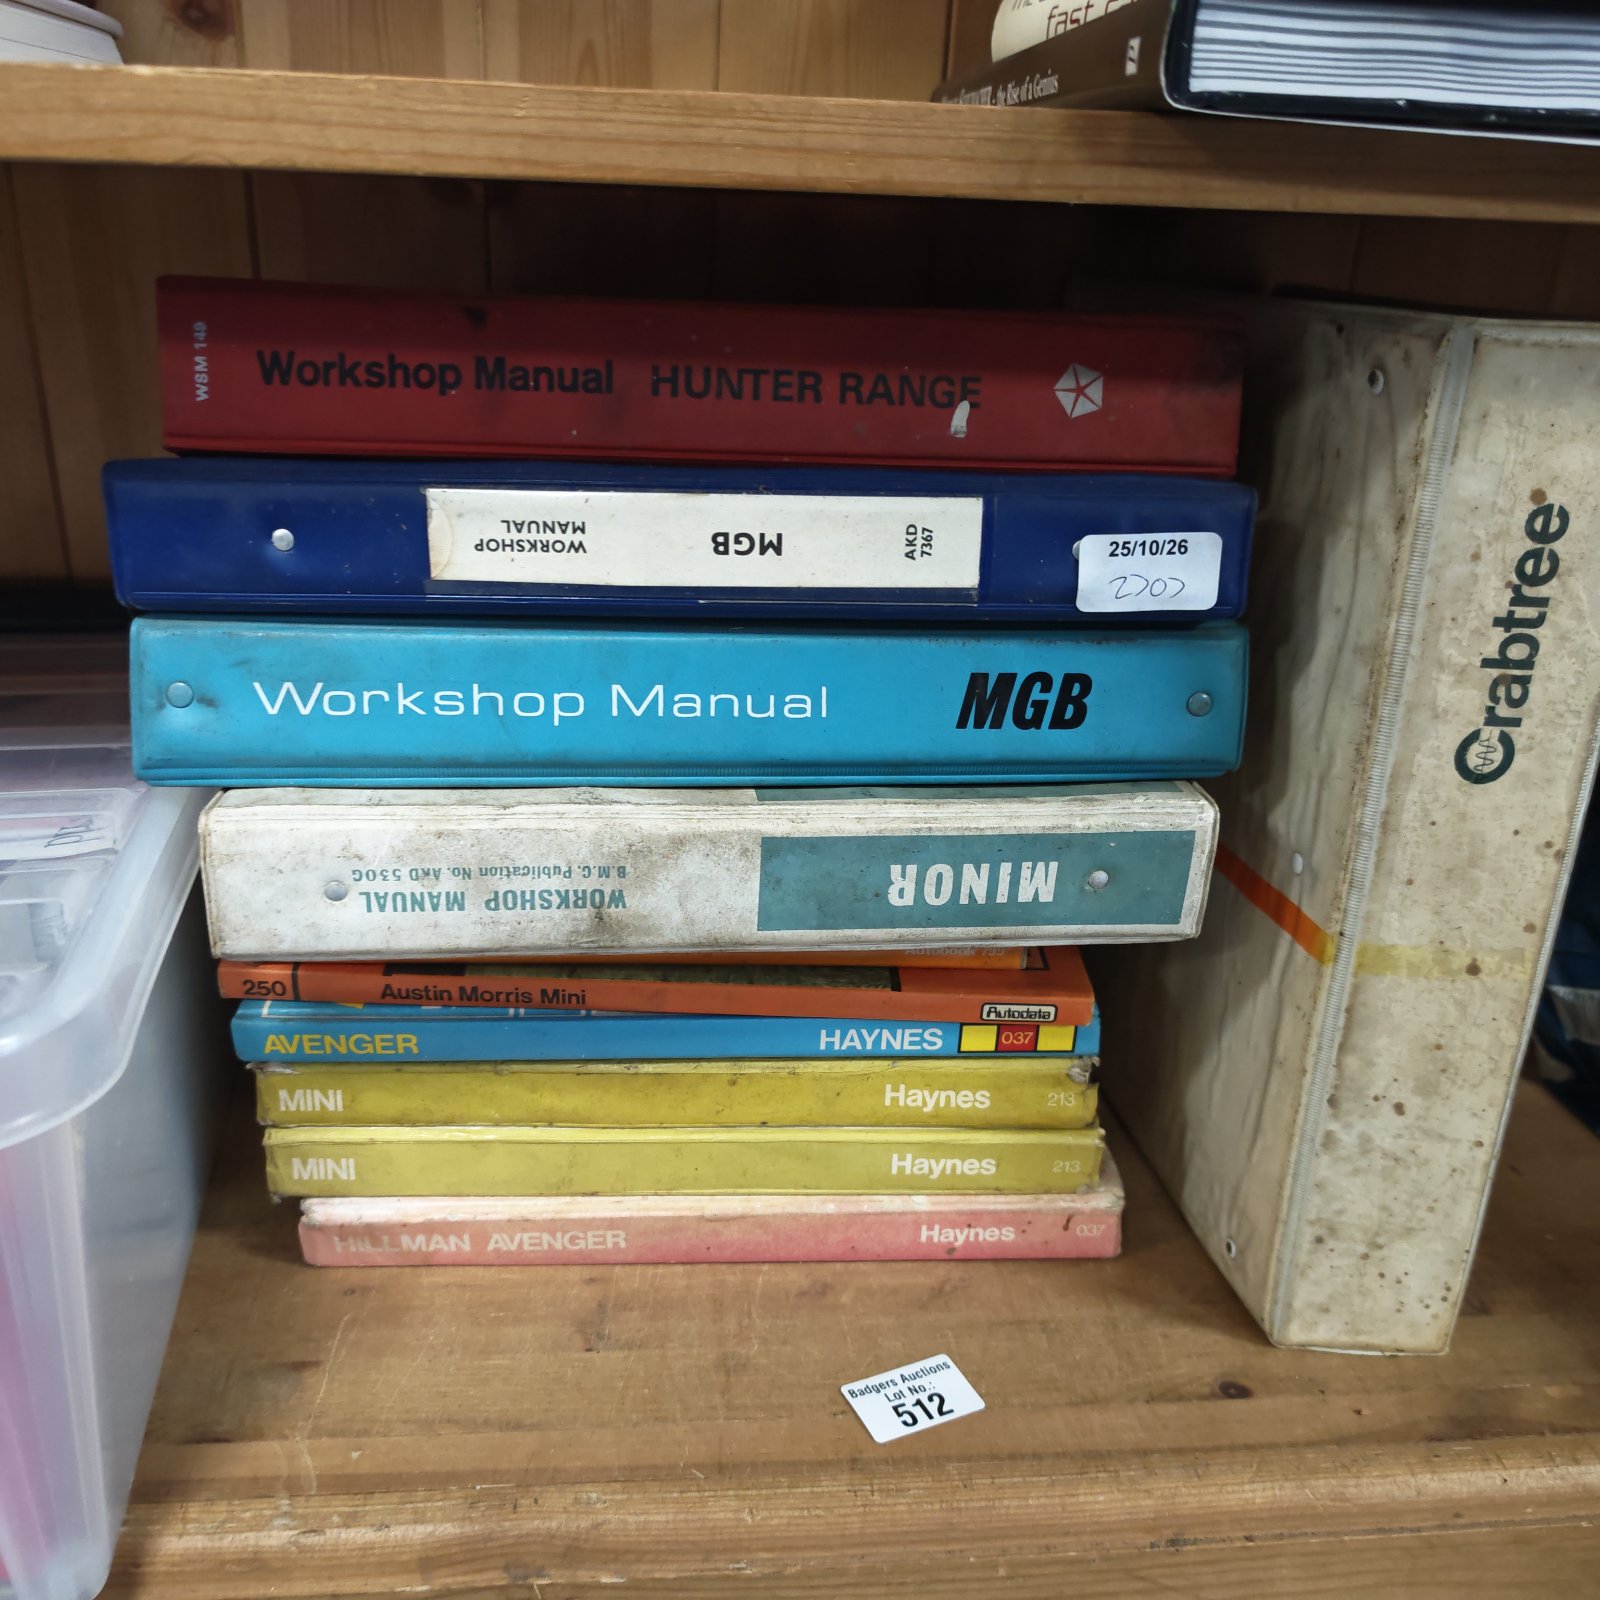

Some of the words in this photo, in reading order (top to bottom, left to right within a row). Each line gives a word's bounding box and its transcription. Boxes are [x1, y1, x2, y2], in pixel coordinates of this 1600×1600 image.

[1033, 68, 1059, 99] Genius
[194, 356, 209, 401] WSM
[256, 349, 462, 396] Workshop
[474, 356, 614, 394] Manual
[650, 364, 822, 404] HUNTER
[838, 372, 982, 409] RANGE
[501, 520, 586, 535] MANUAL
[474, 538, 588, 554] WORKSHOP
[710, 532, 784, 556] MGB
[904, 523, 918, 561] AKD
[920, 526, 934, 558] 7367
[1108, 539, 1189, 557] 25/10/26
[1454, 503, 1570, 785] Crabtree
[253, 682, 585, 726] Workshop
[611, 684, 827, 718] Manual
[955, 671, 1093, 730] MGB
[409, 867, 442, 882] AKD
[447, 867, 472, 880] No.
[479, 866, 573, 879] Publication
[578, 865, 627, 879] B.M.C.
[887, 861, 1058, 906] MINOR
[359, 891, 466, 913] MANUAL
[484, 888, 627, 912] WORKSHOP
[242, 979, 287, 996] 250
[380, 983, 450, 1001] Austin
[458, 986, 532, 1004] Morris
[540, 988, 586, 1006] Mini
[986, 1006, 1051, 1020] Autodata
[264, 1034, 419, 1055] AVENGER
[819, 1028, 943, 1050] HAYNES
[1001, 1031, 1033, 1045] 037
[278, 1089, 344, 1112] MINI
[884, 1083, 991, 1113] Haynes
[1047, 1093, 1075, 1107] 213
[291, 1157, 356, 1181] MINI
[891, 1153, 997, 1179] Haynes
[1052, 1160, 1081, 1173] 213
[334, 1233, 470, 1253] HILLMAN
[487, 1230, 626, 1251] AVENGER
[919, 1224, 1016, 1245] Haynes
[1076, 1224, 1106, 1237] 037
[848, 1377, 898, 1399] Badgers
[900, 1360, 951, 1385] Auctions
[884, 1389, 907, 1403] Lot
[891, 1392, 955, 1428] 512
